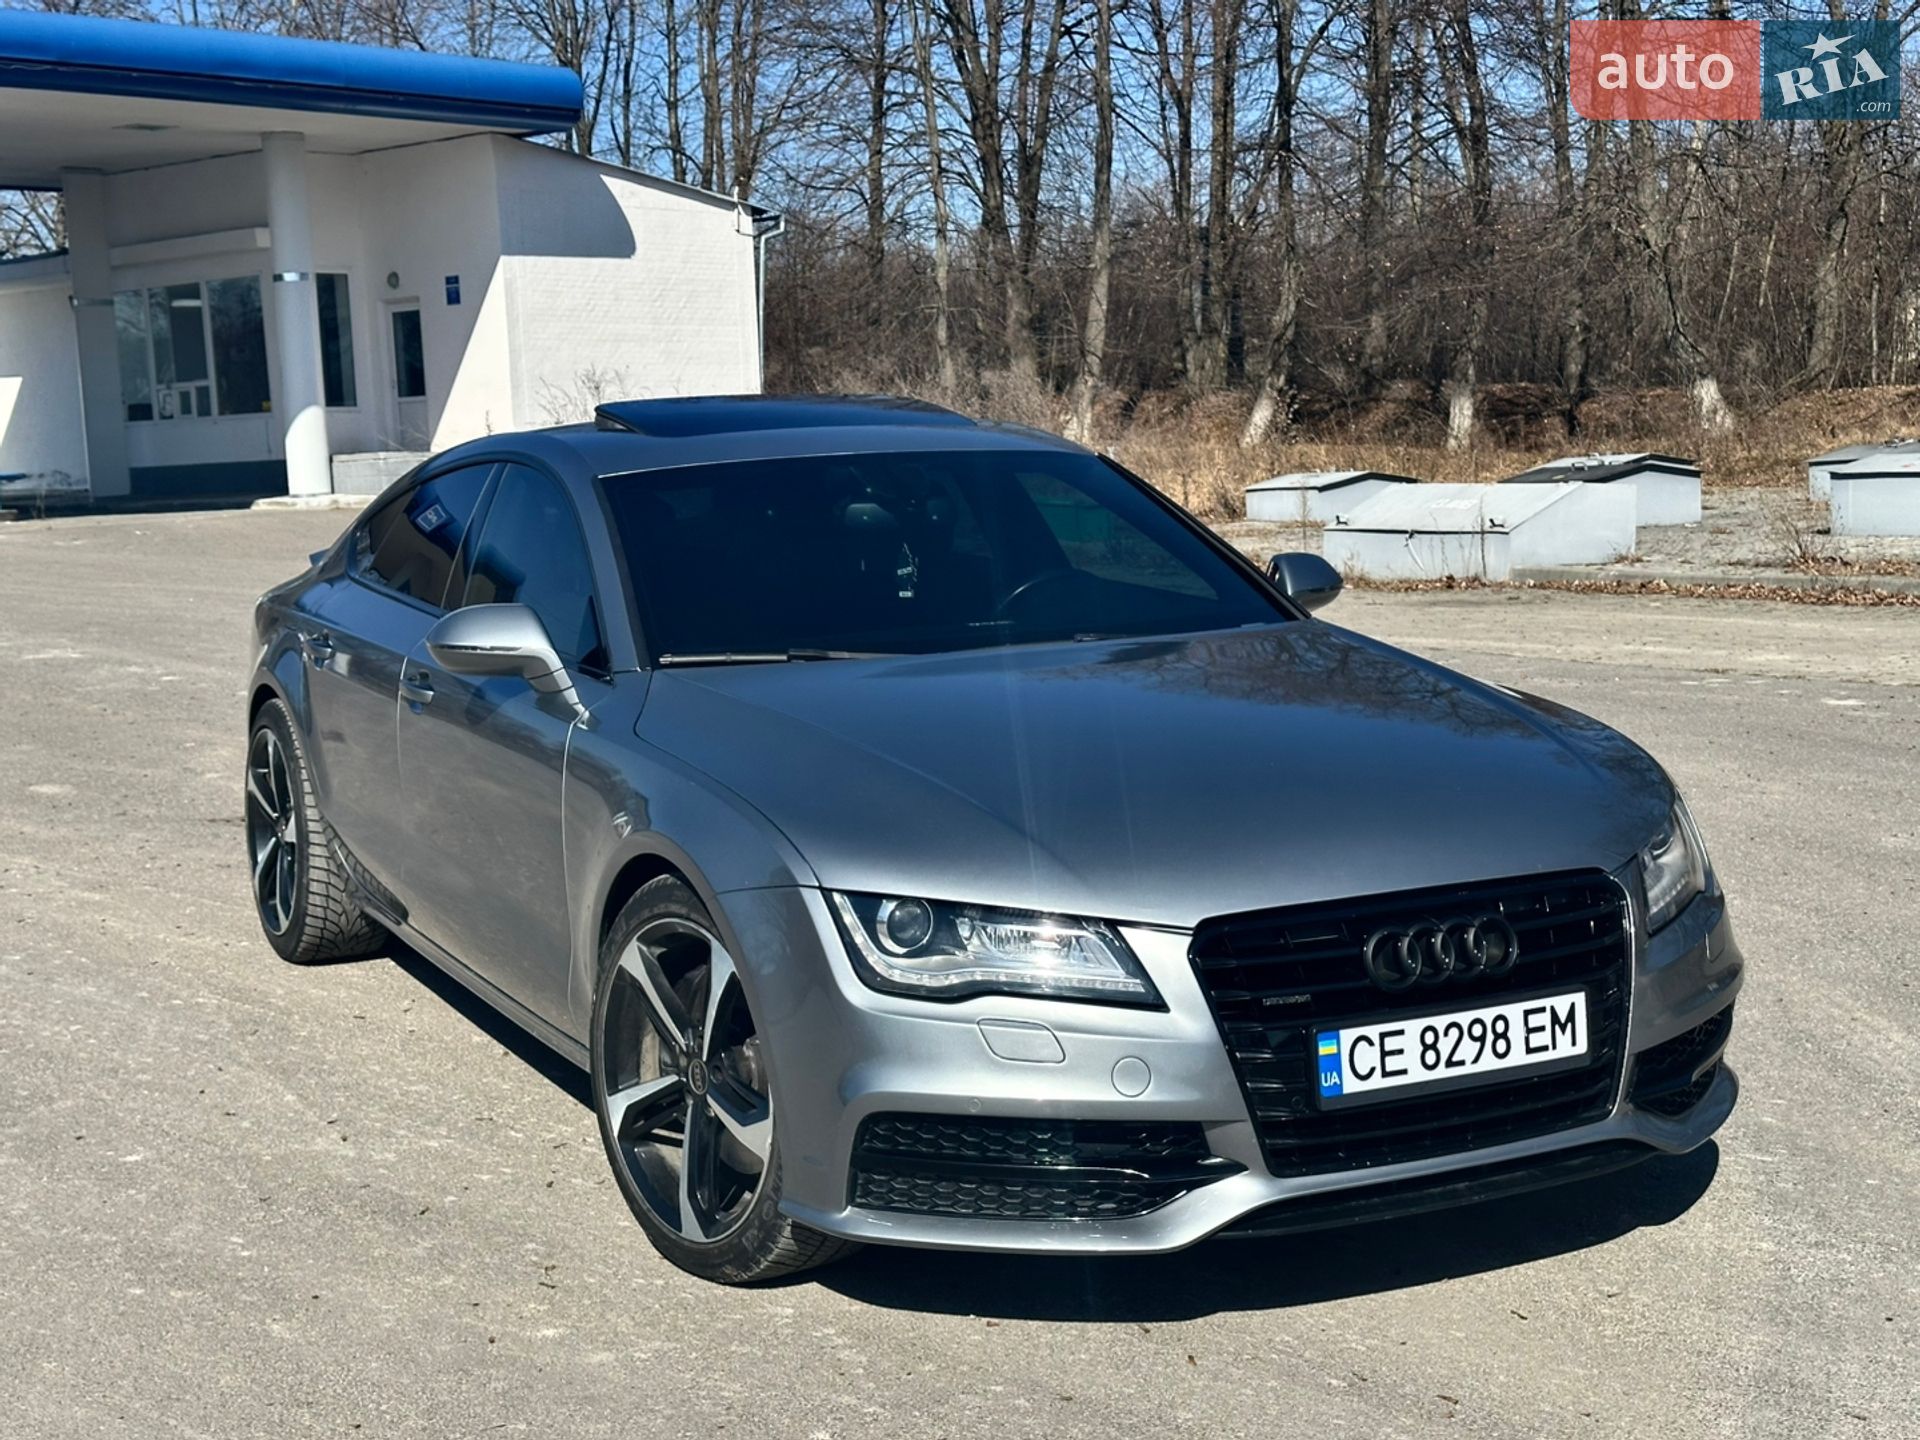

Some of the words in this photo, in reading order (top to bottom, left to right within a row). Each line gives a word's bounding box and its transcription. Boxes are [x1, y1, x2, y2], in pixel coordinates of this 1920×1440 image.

[1349, 1029, 1408, 1081] CE
[1419, 1014, 1511, 1071] 8298
[1523, 1002, 1577, 1055] EM
[1321, 1071, 1341, 1087] UA
